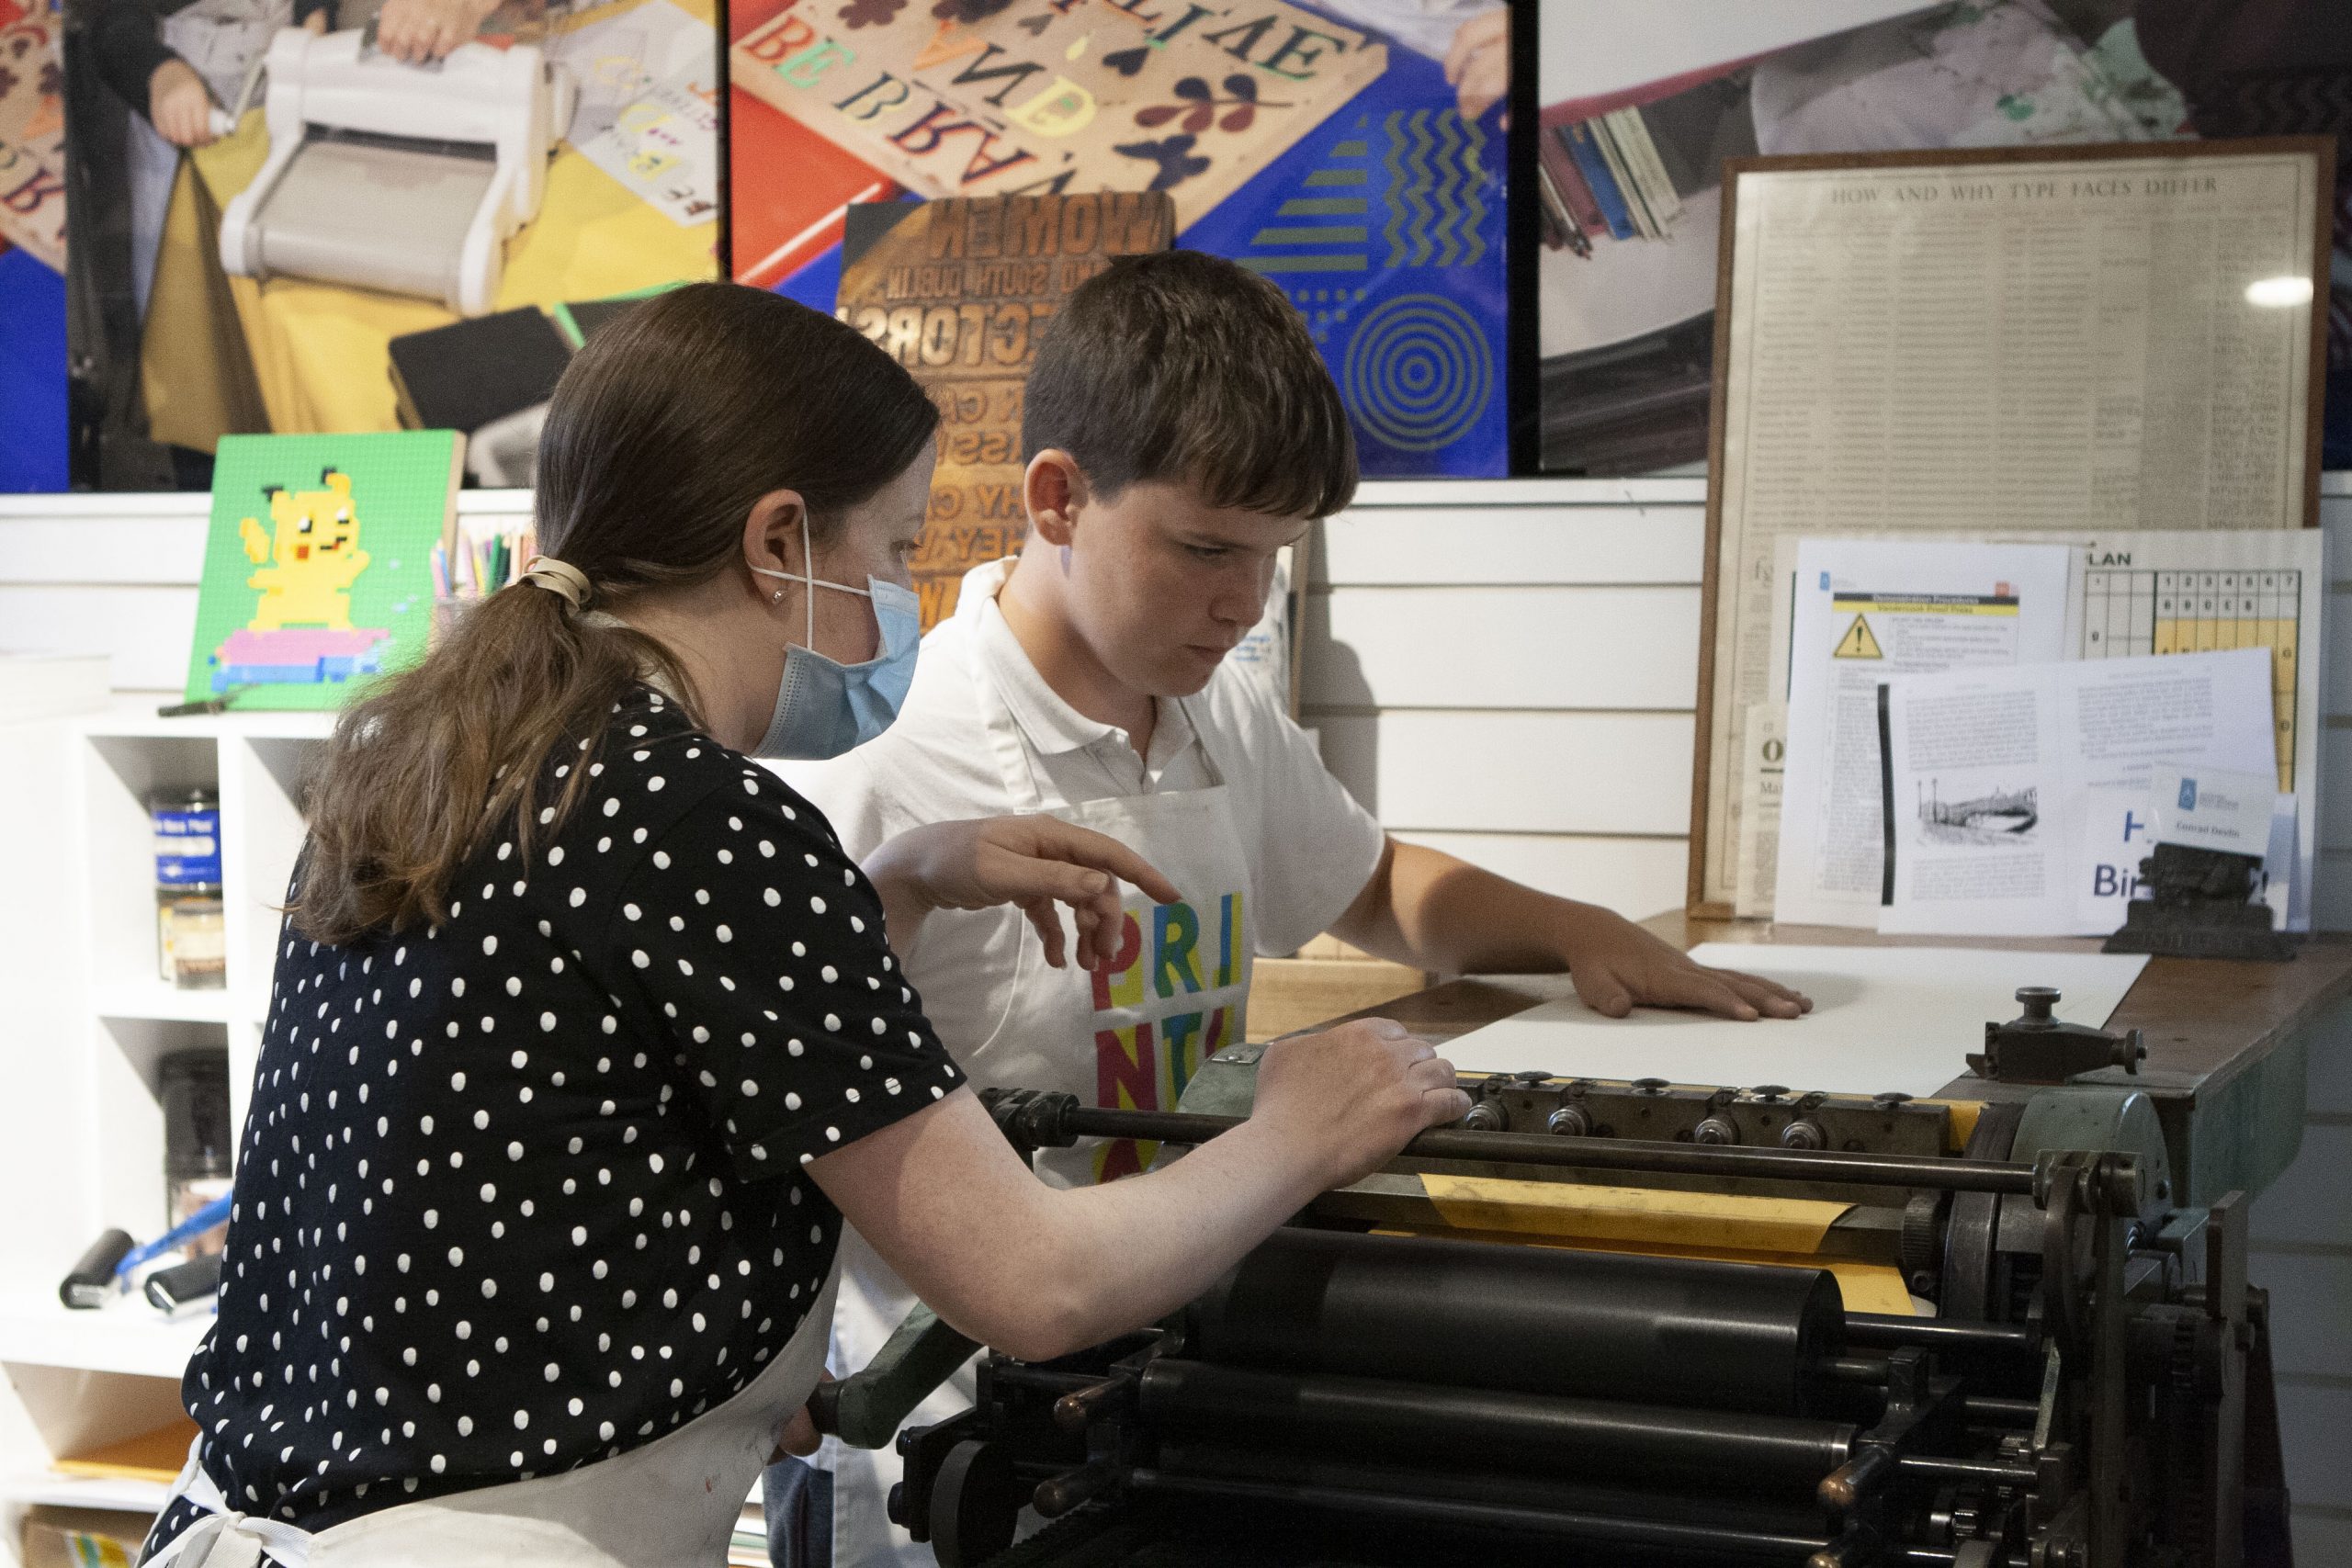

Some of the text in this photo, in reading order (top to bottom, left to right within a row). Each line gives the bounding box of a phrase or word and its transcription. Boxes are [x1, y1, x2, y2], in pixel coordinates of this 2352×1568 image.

[1832, 187, 1880, 205] HOW
[1894, 186, 1939, 203] AND
[1950, 183, 1995, 201] WHY
[2009, 181, 2057, 199] TYPE
[2070, 179, 2132, 198] FACES
